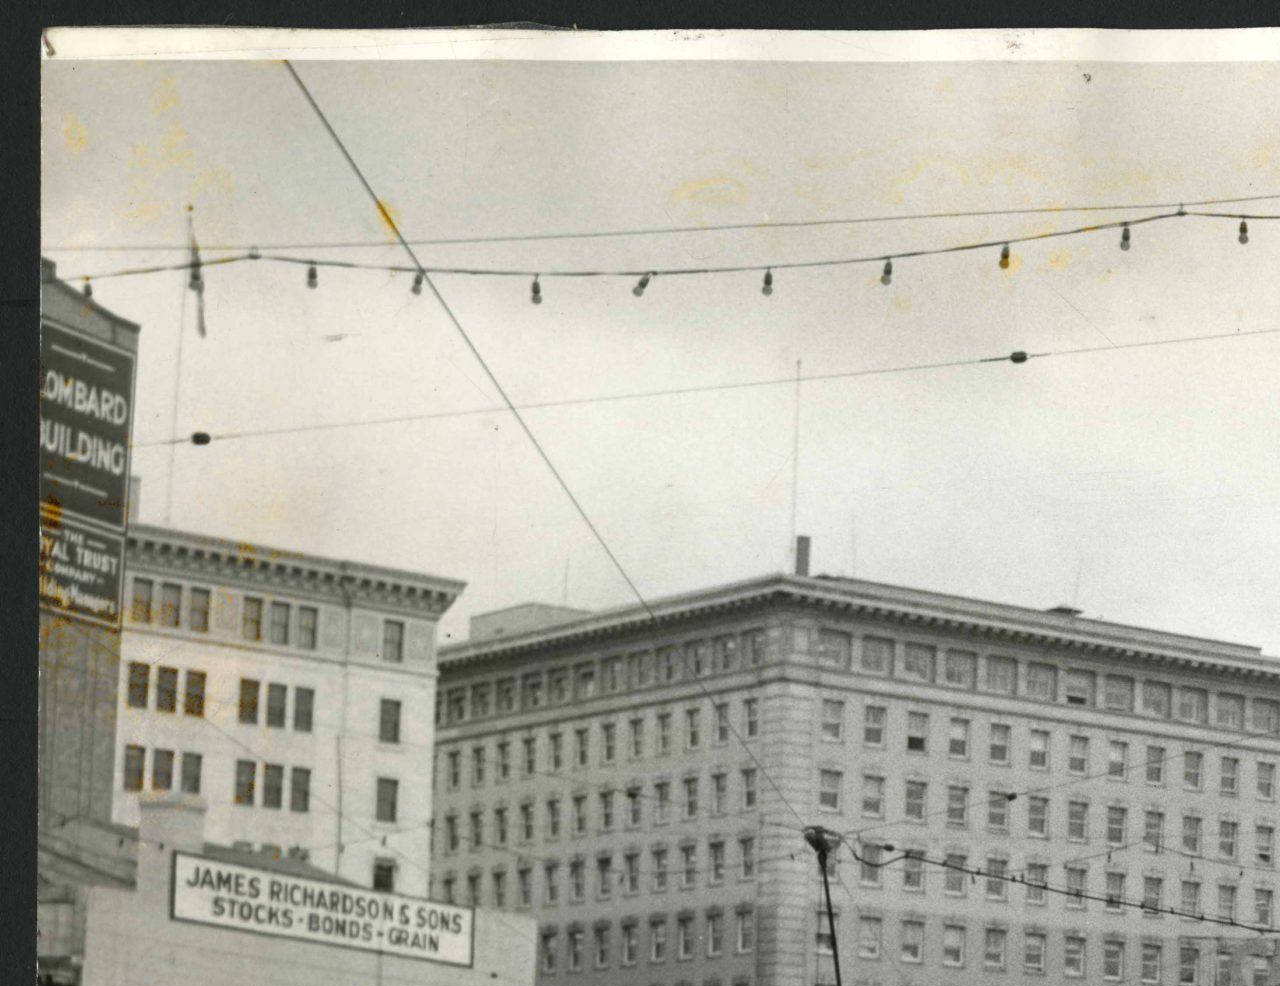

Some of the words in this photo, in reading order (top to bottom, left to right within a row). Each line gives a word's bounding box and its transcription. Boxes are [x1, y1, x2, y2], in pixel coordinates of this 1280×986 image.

[40, 369, 127, 426] OMBARD
[40, 536, 70, 562] YAL
[76, 545, 119, 576] TRUST
[63, 529, 85, 546] THE
[186, 865, 261, 898] JAMES
[269, 879, 394, 920] RICHARDSON
[399, 903, 411, 926] &
[416, 907, 464, 935] SONS
[213, 897, 294, 929] STOCKS
[307, 912, 374, 942] BONDS
[388, 926, 440, 953] GRAIN
